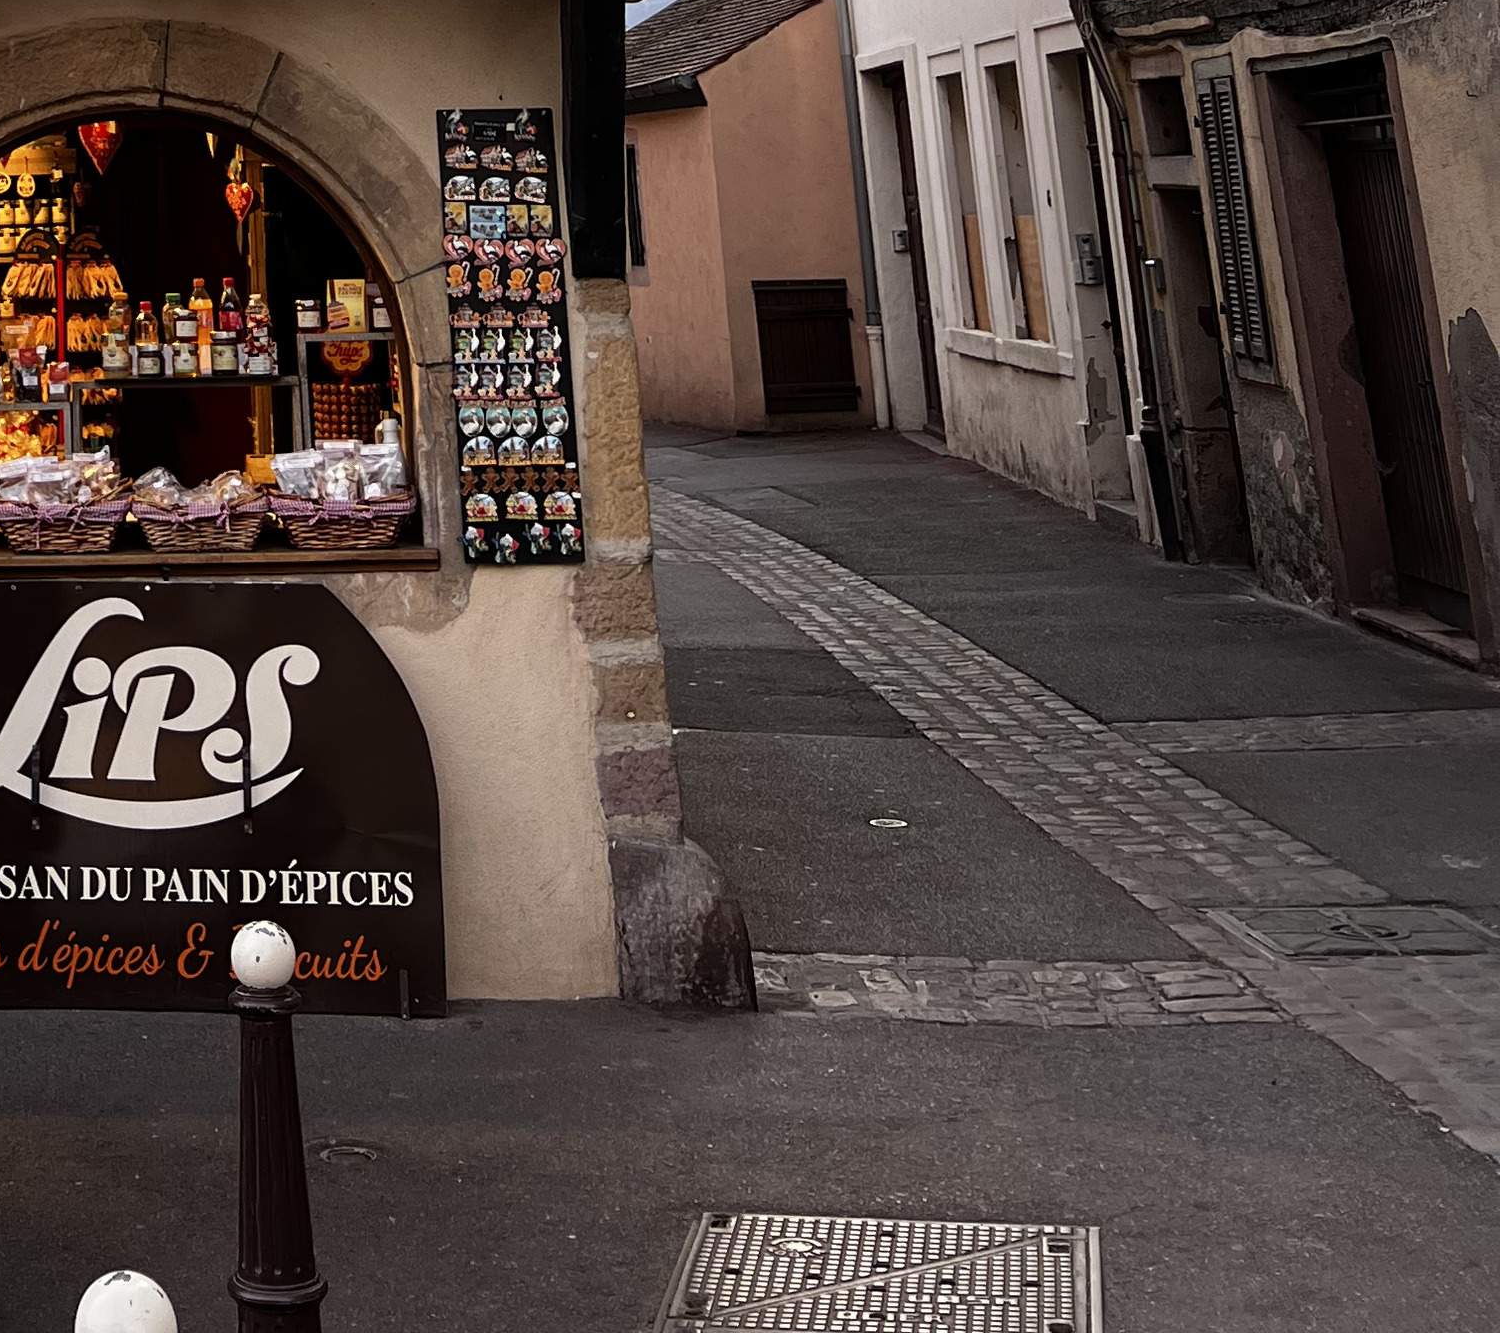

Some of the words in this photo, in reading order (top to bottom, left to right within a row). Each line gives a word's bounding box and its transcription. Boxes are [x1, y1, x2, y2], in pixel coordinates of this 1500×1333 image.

[80, 866, 132, 902] DU
[143, 867, 231, 904] PAIN
[240, 859, 416, 908] D'ÉPICES
[17, 918, 165, 989] d'épices
[177, 921, 217, 981] &
